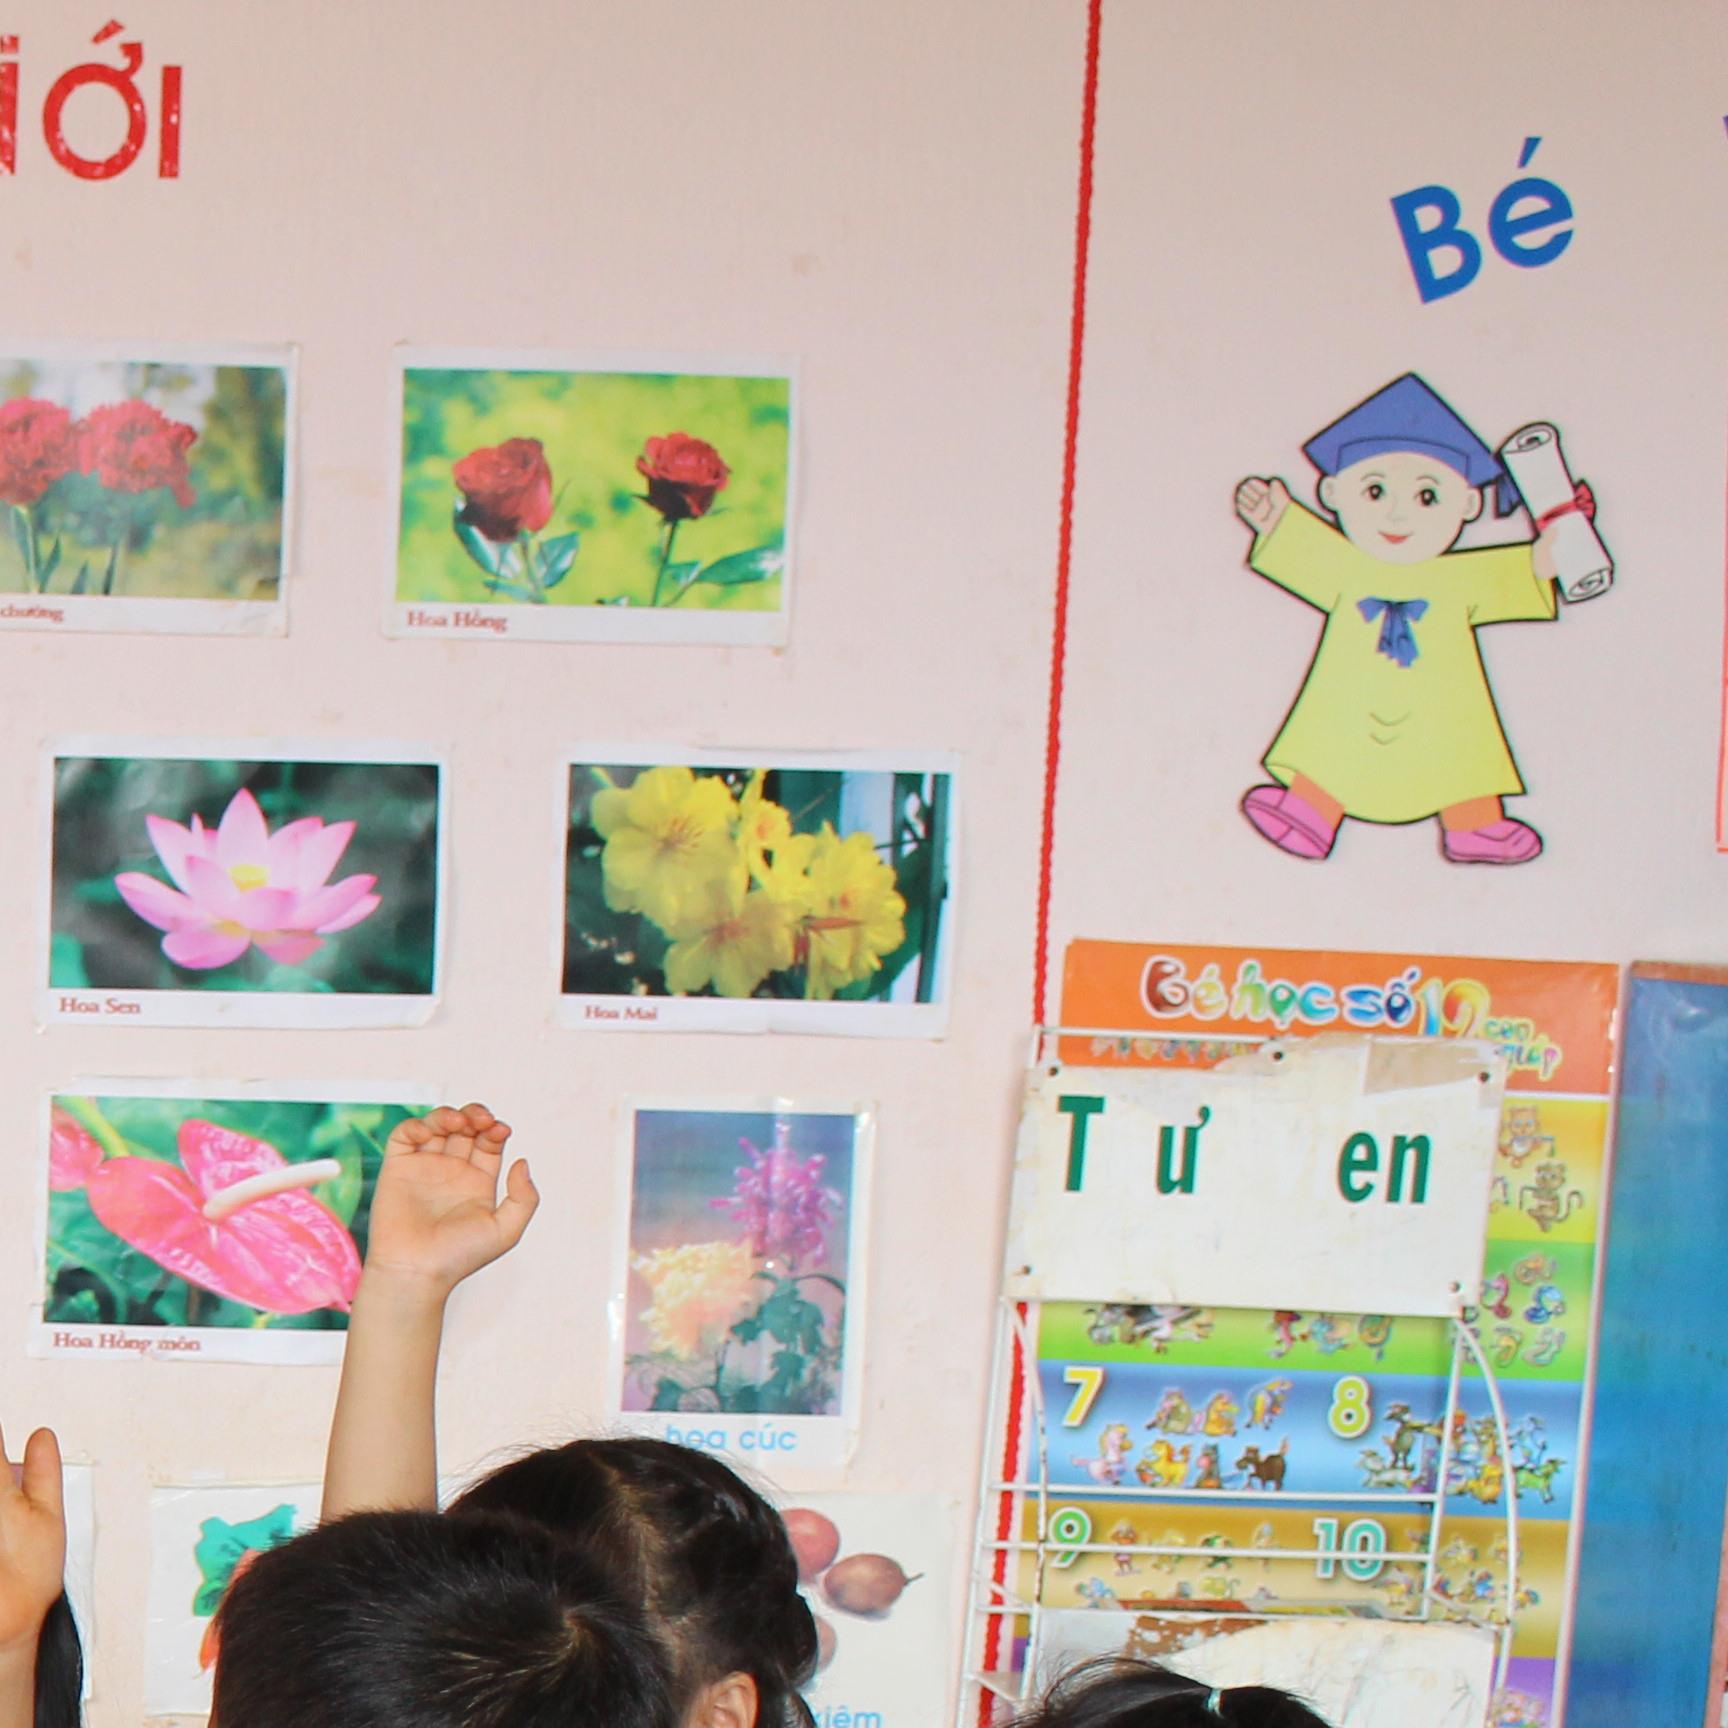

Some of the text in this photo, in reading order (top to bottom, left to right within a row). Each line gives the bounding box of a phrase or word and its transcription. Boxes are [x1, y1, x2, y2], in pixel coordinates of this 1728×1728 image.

[1390, 136, 1574, 305] Bé
[408, 611, 447, 626] Hoa
[60, 998, 141, 1014] Hoa Sen
[585, 1005, 619, 1019] Hoa
[1142, 956, 1420, 1028] Bé học số
[1336, 1131, 1432, 1205] en
[53, 1333, 92, 1348] Hoa
[1062, 1367, 1105, 1428] 7
[1327, 1375, 1372, 1438] 8
[739, 1422, 796, 1450] cúc
[1047, 1506, 1092, 1568] 9
[1312, 1516, 1387, 1581] 10
